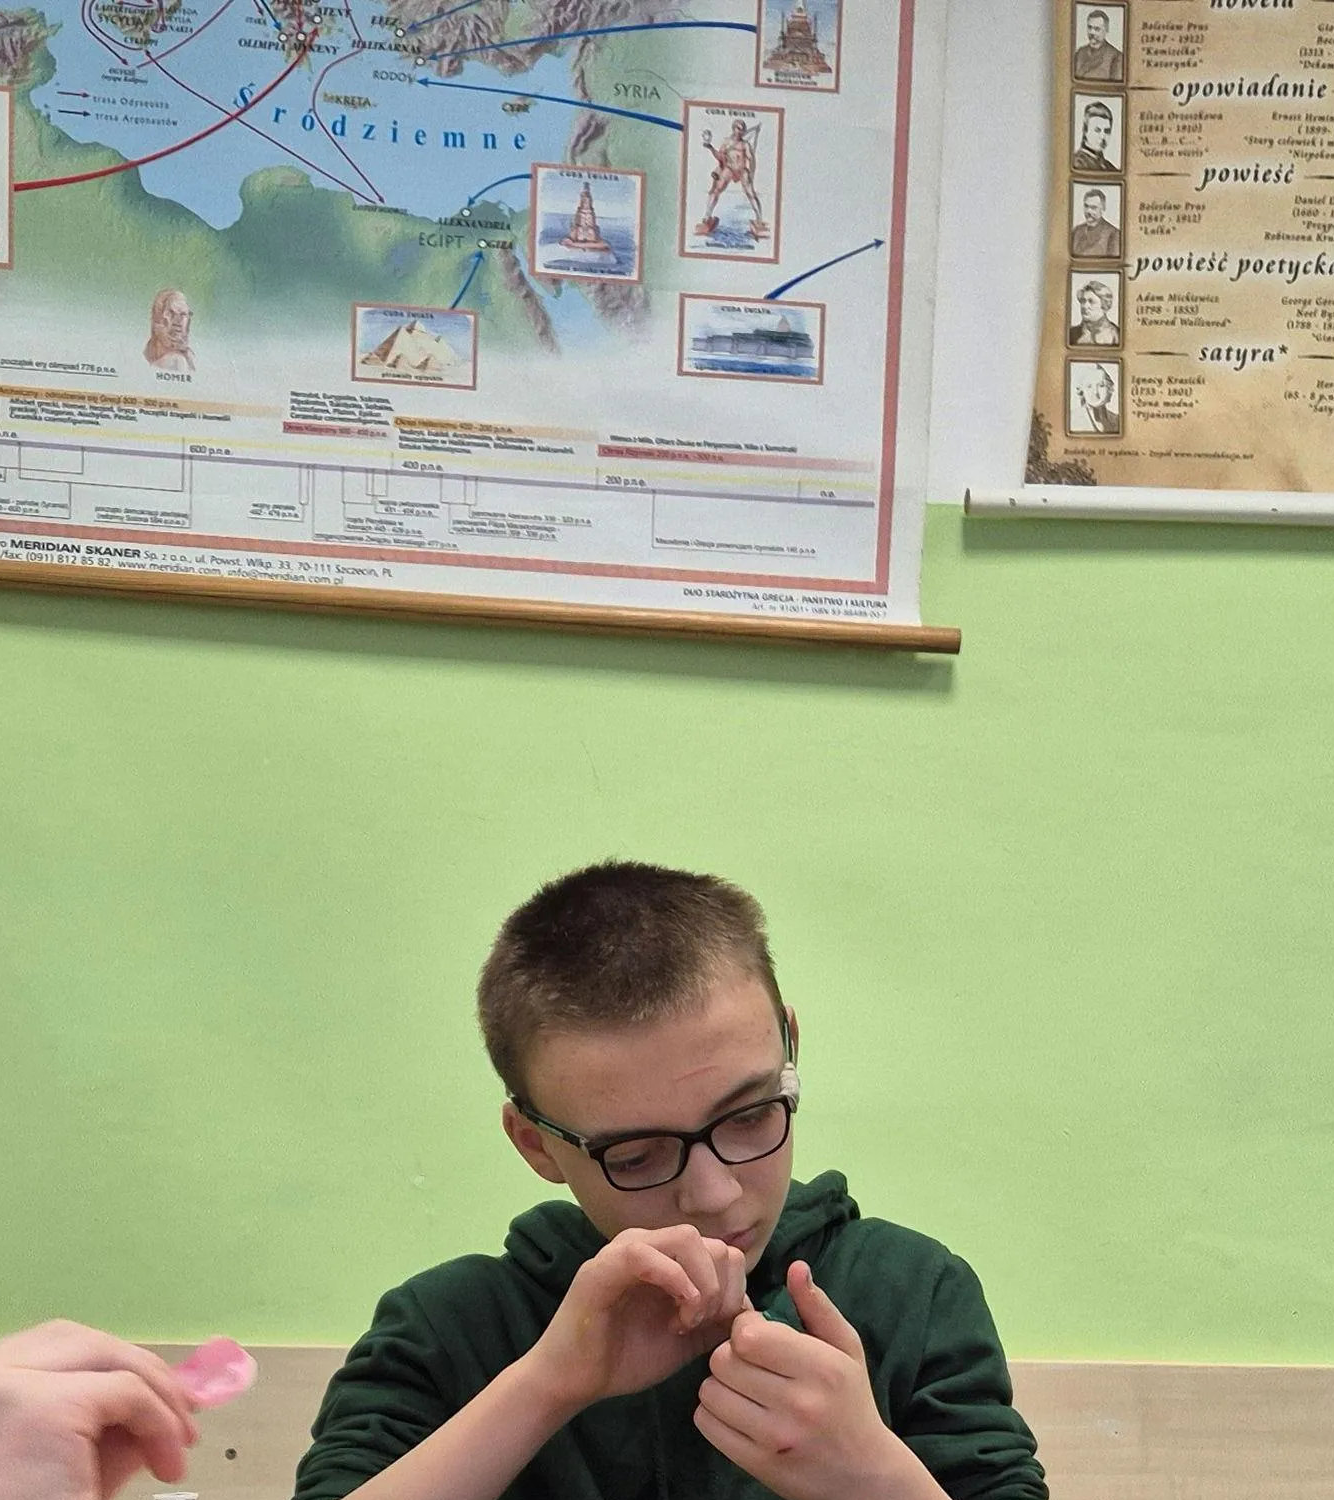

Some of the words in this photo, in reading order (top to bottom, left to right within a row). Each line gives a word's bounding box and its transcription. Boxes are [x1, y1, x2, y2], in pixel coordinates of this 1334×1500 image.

[613, 82, 662, 101] SYRIA
[1171, 73, 1328, 106] opowiadanie
[232, 82, 527, 151] Śródziemne
[1194, 163, 1295, 192] powieść
[418, 232, 465, 249] EGIPT
[1127, 252, 1229, 281] powieść
[155, 371, 193, 384] HOMER
[10, 539, 82, 555] MERIDIAN
[85, 544, 142, 559] SKANER
[25, 551, 55, 566] (091)
[57, 553, 78, 566] 812
[81, 556, 96, 567] 85
